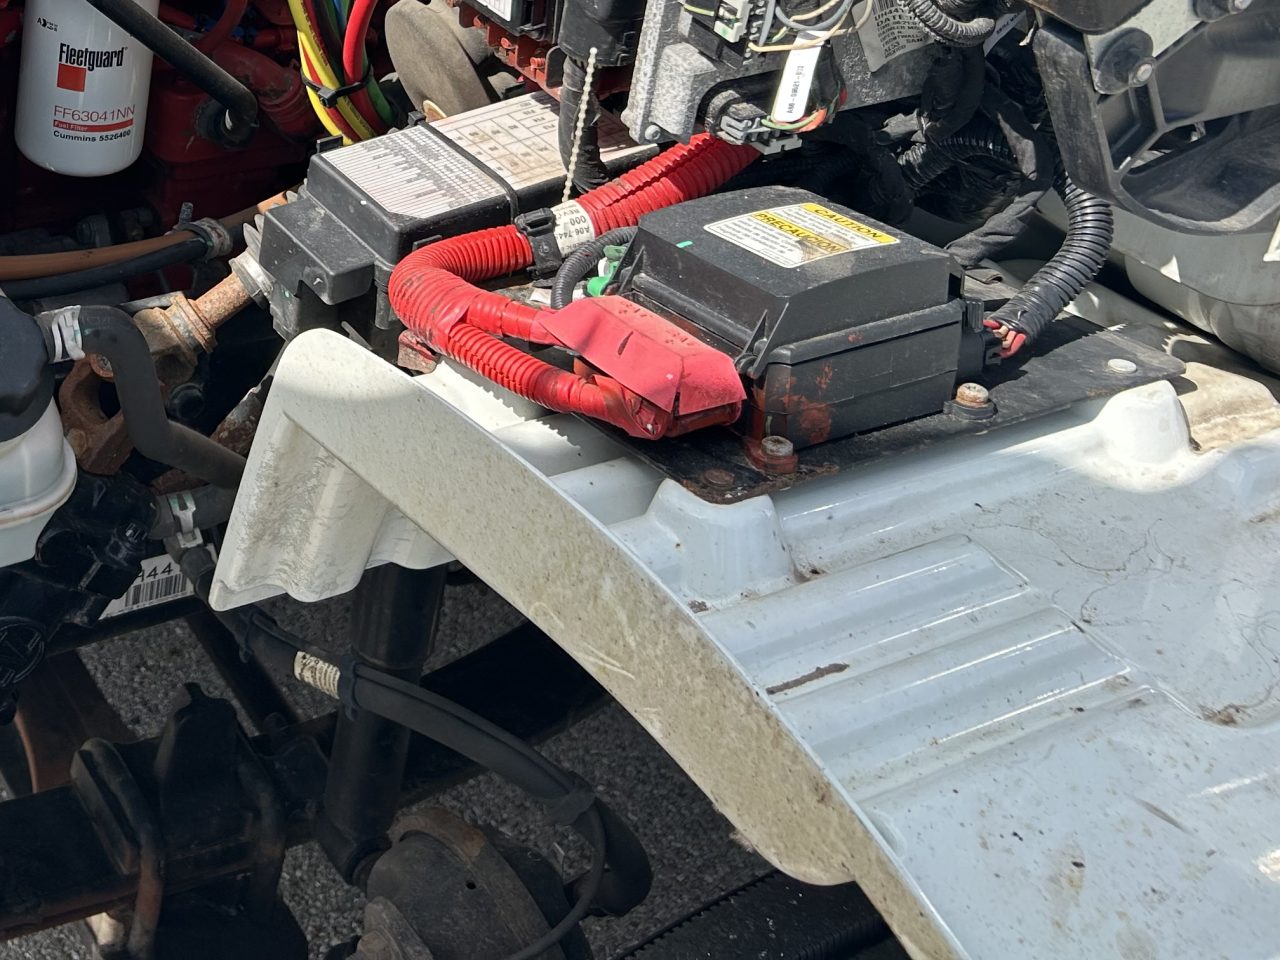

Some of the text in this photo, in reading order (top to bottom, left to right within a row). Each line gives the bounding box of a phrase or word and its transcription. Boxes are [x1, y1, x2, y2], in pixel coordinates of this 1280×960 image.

[59, 43, 124, 71] Fleetguard
[54, 105, 135, 122] FF63041NN
[54, 121, 88, 131] Fuel Filter
[54, 130, 96, 142] Cummins
[815, 208, 883, 238] CAUTION
